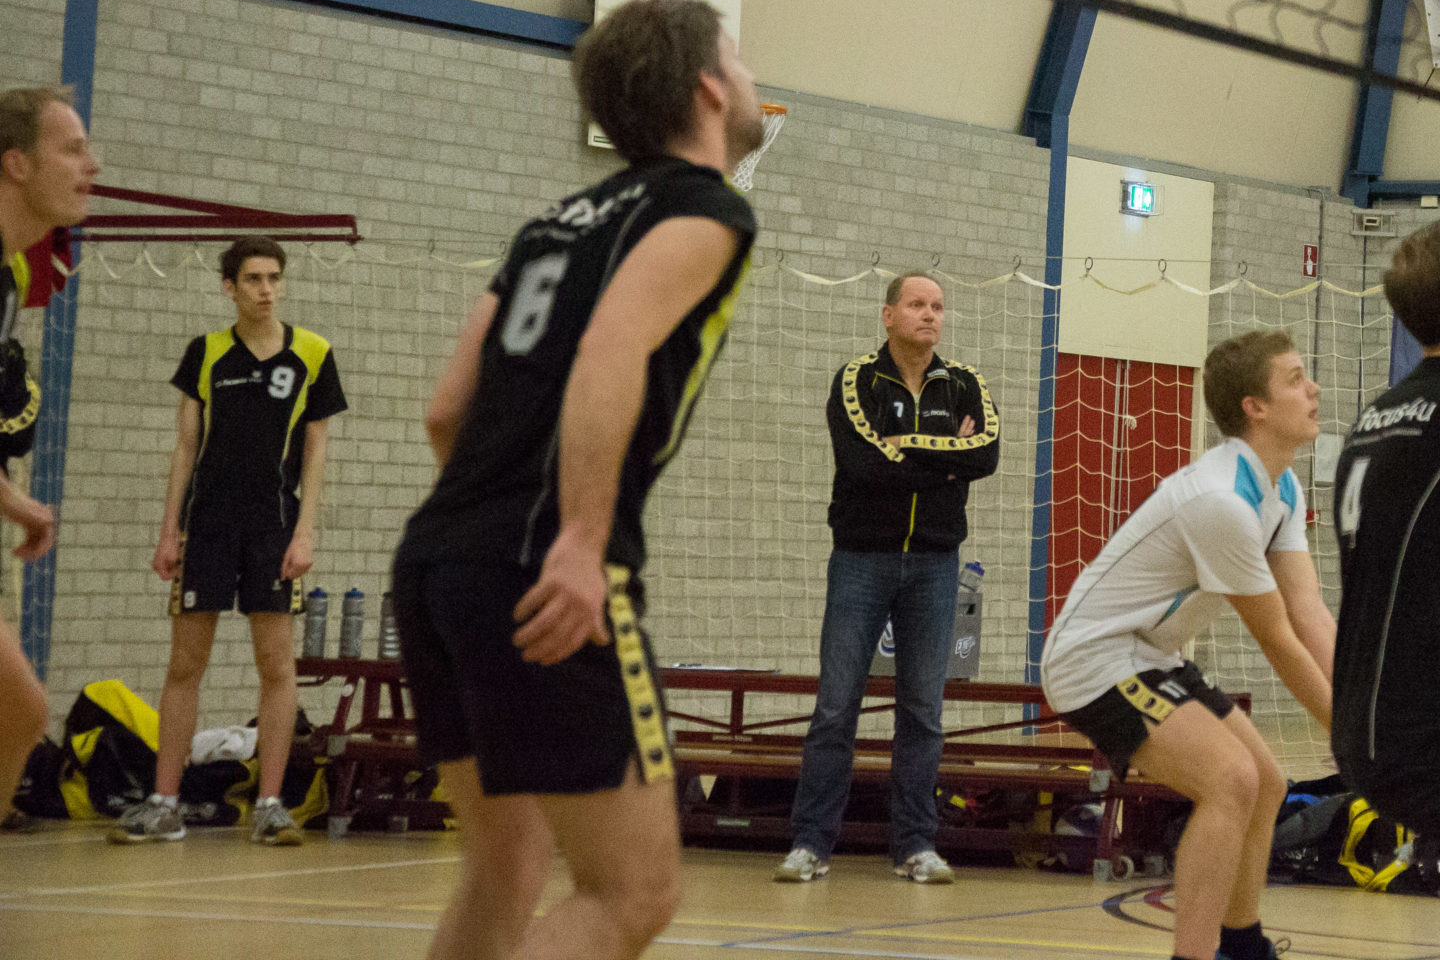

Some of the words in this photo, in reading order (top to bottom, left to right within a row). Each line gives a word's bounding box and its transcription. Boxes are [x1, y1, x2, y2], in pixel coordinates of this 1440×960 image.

[503, 253, 569, 356] 6
[268, 366, 295, 399] 9
[893, 401, 904, 418] 7
